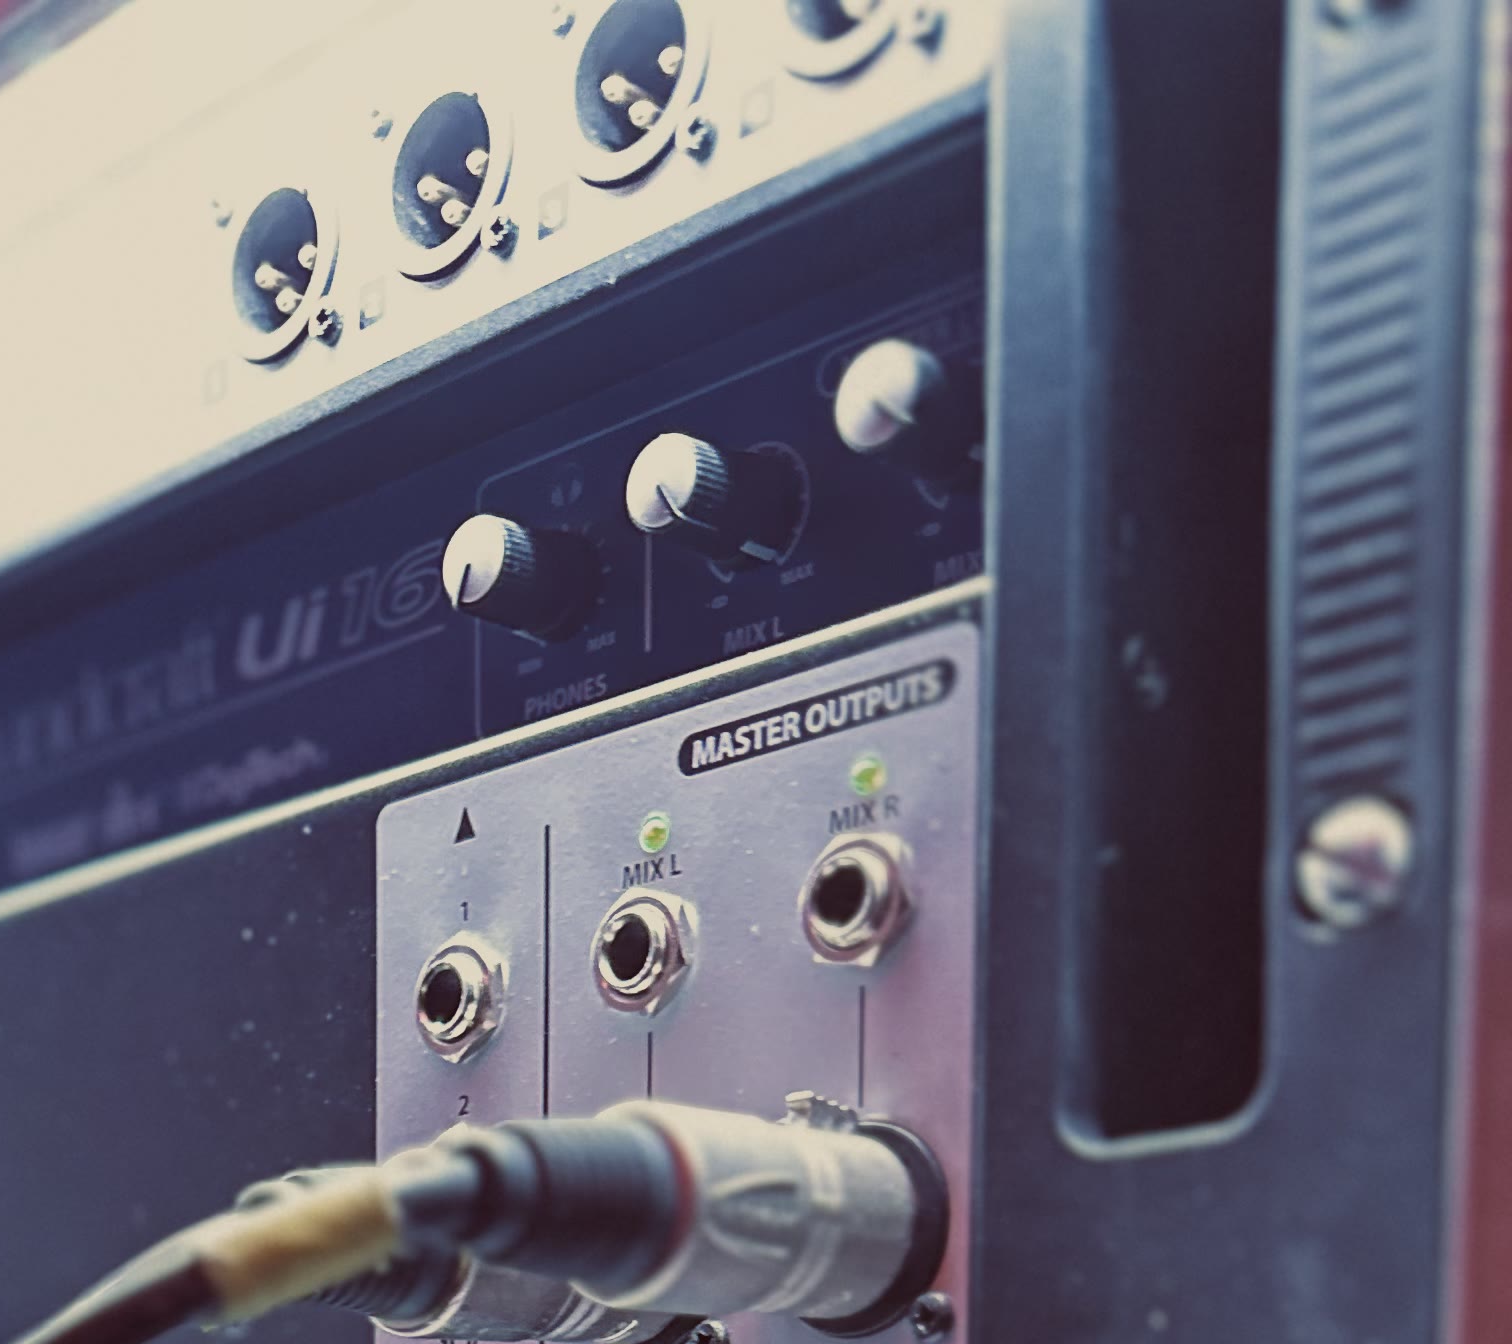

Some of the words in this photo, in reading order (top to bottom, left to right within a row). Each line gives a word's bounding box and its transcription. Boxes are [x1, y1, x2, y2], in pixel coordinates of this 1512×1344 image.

[723, 620, 767, 656] MIX
[523, 673, 608, 720] PHONES
[691, 712, 801, 769] MASTER
[805, 665, 942, 733] OUTPUTS
[828, 801, 876, 834] MIX
[883, 795, 901, 818] R
[622, 857, 664, 889] MIX
[670, 853, 683, 876] L
[460, 901, 469, 922] 1
[458, 1094, 470, 1116] 2
